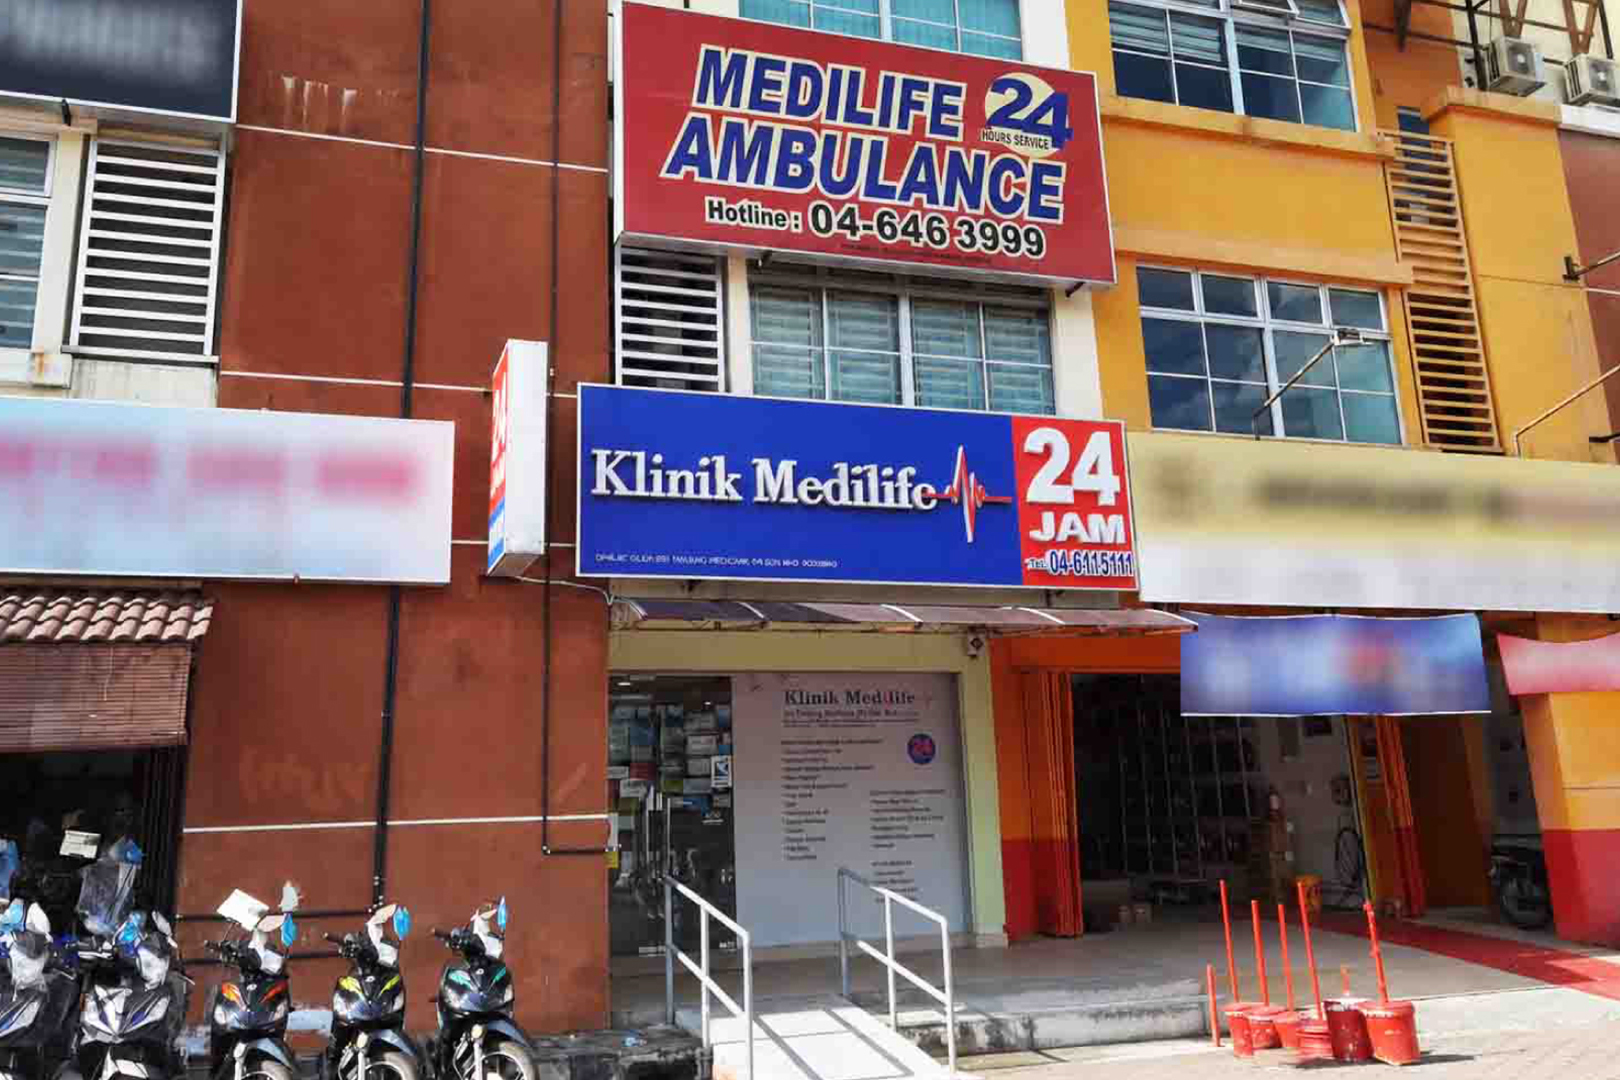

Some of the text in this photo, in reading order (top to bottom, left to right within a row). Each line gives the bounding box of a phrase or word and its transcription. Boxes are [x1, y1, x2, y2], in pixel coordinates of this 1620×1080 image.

[693, 45, 966, 140] MEDILIFE
[986, 77, 1074, 151] 24
[660, 113, 1066, 223] AMBULANCE
[982, 130, 1049, 150] HOURS SERVICE
[810, 204, 948, 246] 04-646
[956, 218, 1047, 258] 3999
[591, 449, 938, 511] Klinik Medilife
[1024, 427, 1120, 506] 24
[1029, 511, 1127, 544] JAM
